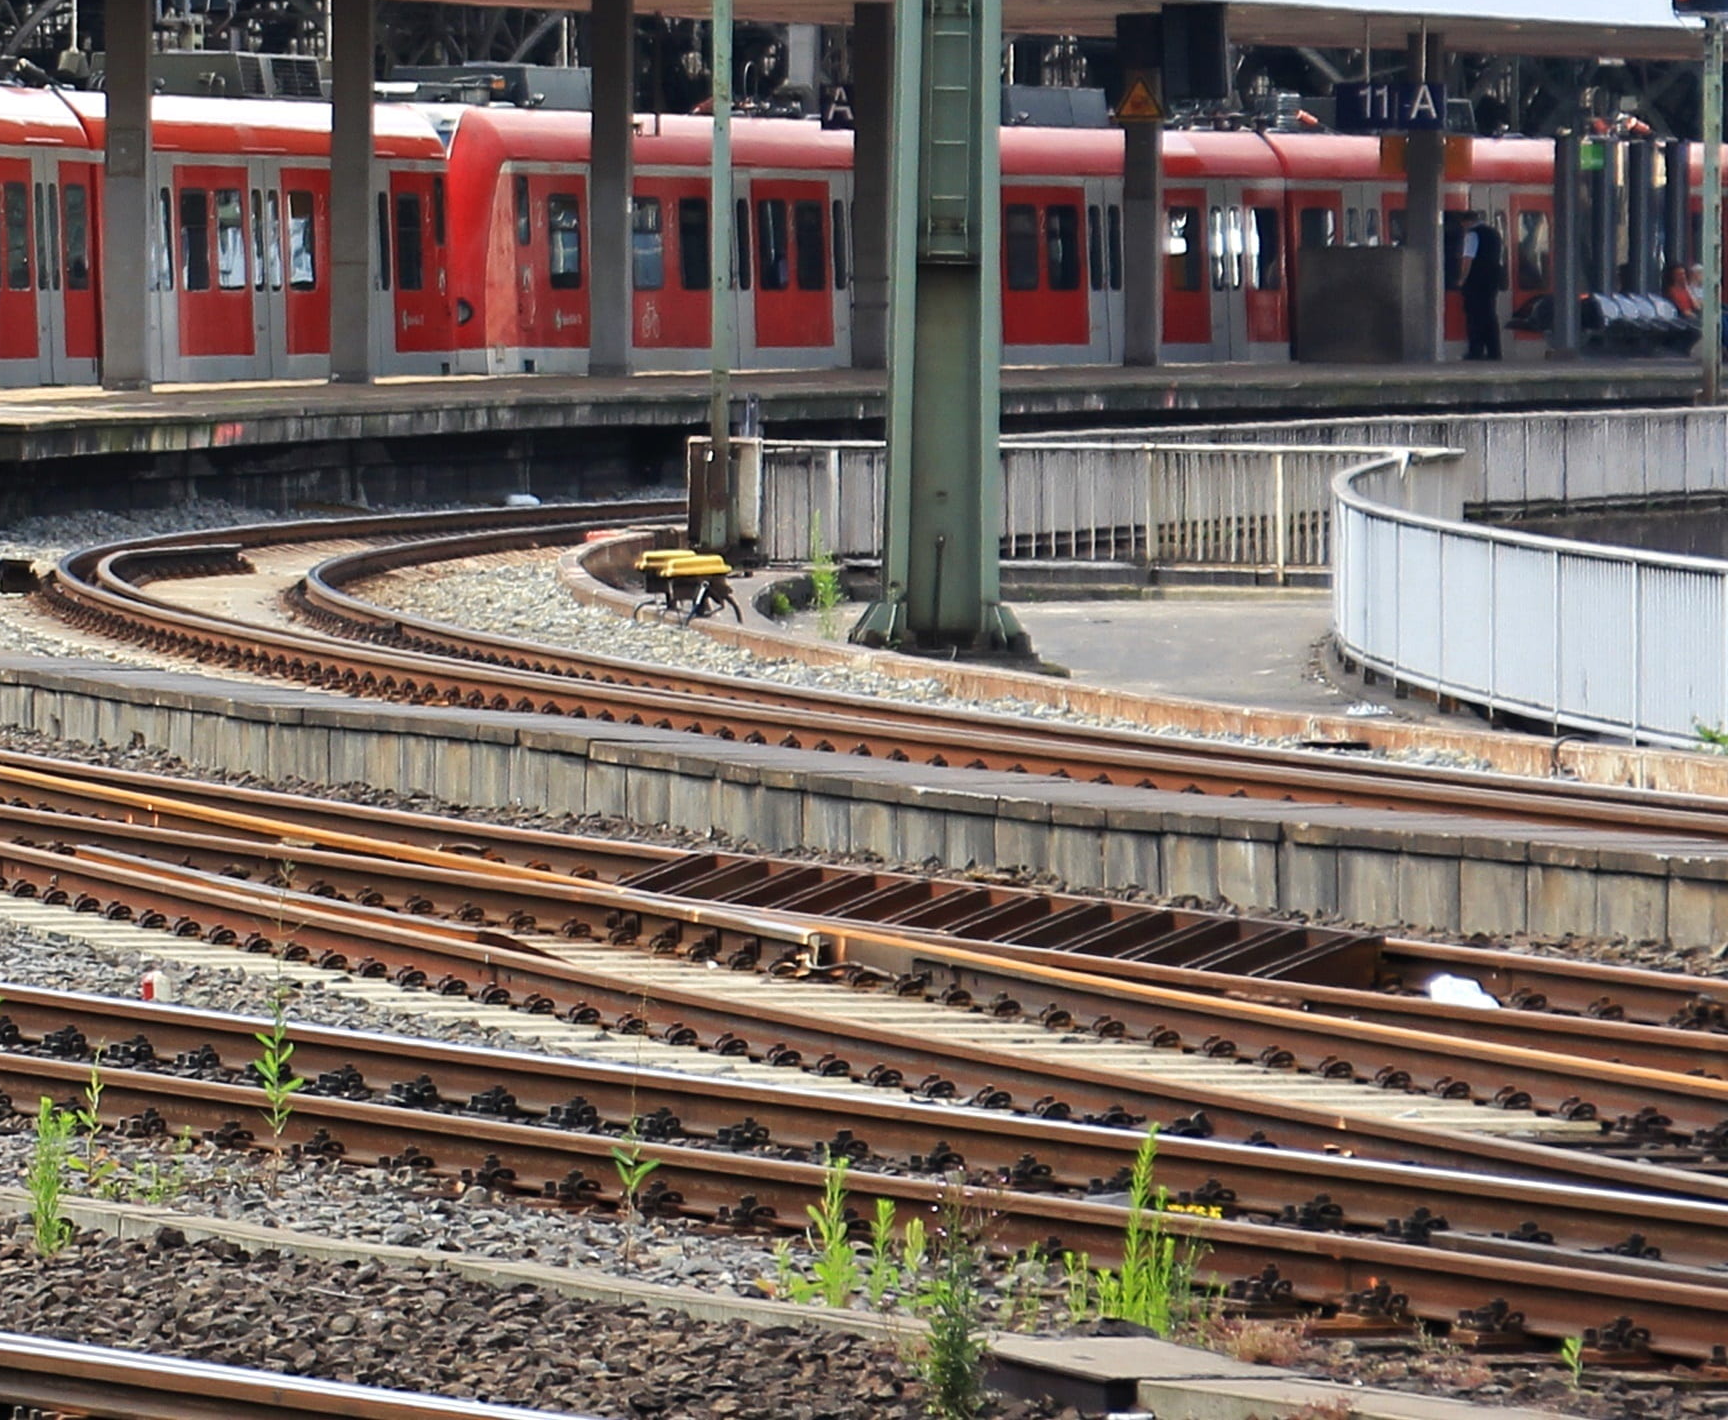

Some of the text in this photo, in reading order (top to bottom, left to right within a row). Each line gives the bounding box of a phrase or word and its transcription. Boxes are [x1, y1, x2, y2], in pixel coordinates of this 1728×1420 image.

[828, 86, 854, 120] A
[1359, 84, 1437, 119] 11 A
